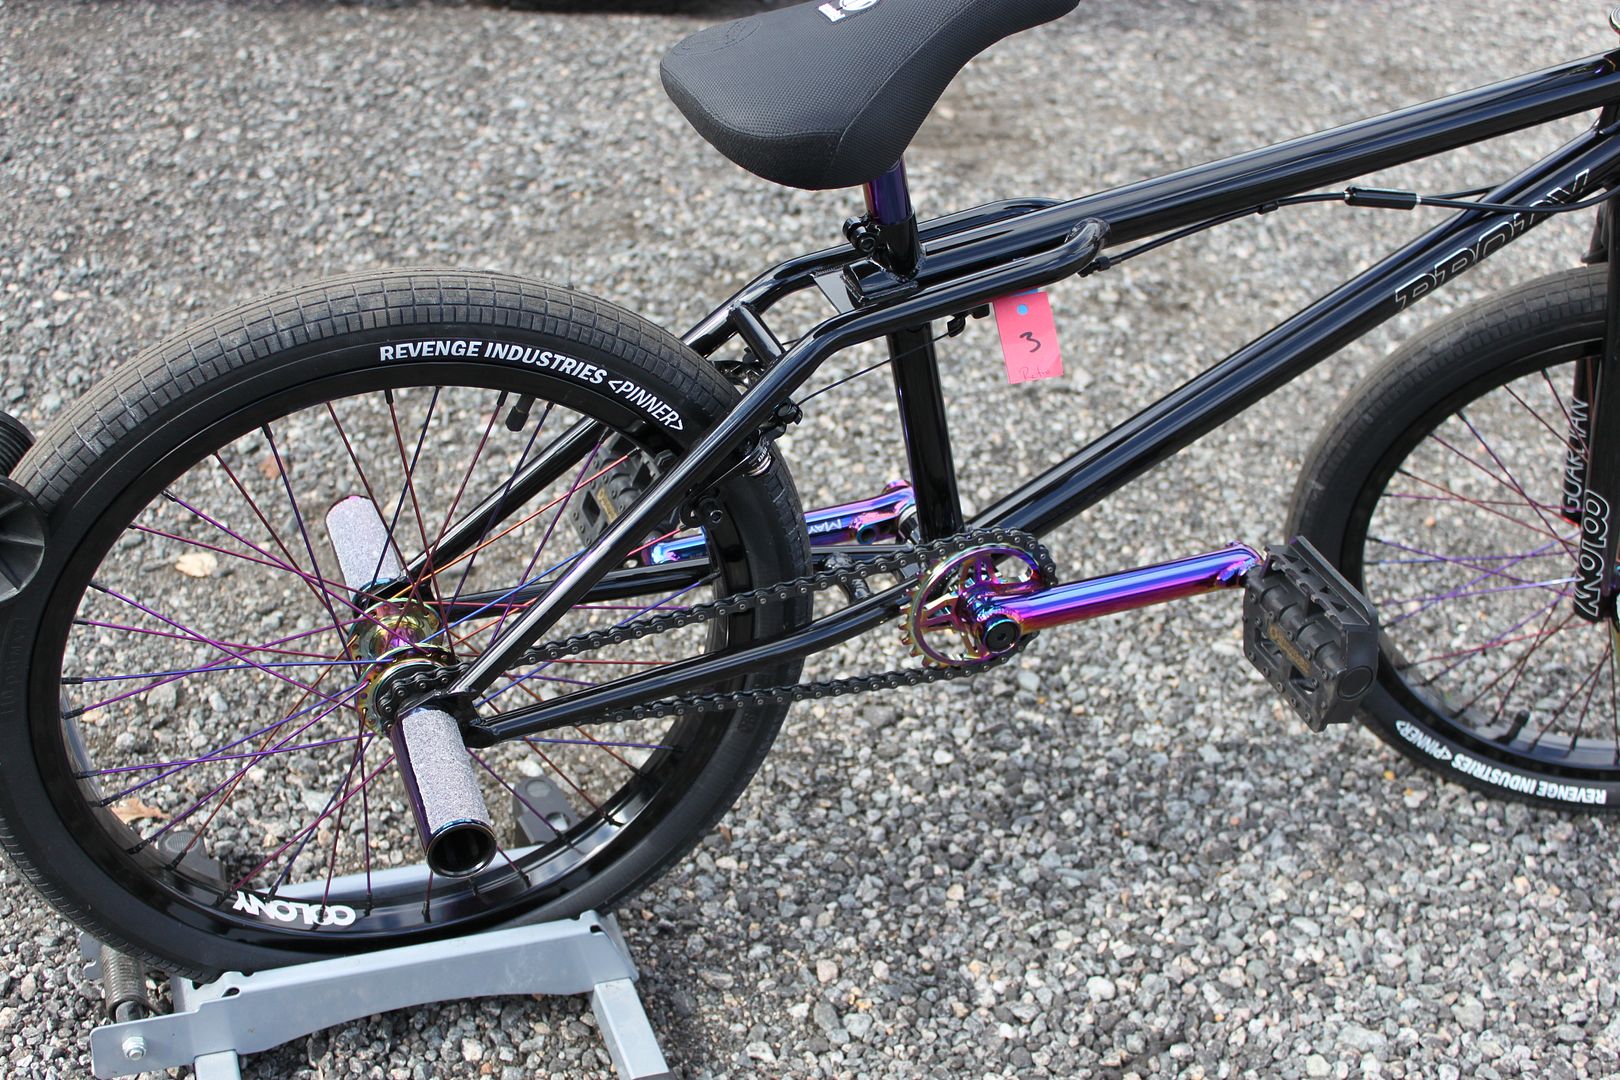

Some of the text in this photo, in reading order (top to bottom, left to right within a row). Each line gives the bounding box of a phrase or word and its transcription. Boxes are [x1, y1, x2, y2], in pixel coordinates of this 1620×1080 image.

[1019, 331, 1041, 353] 3
[379, 340, 482, 361] REVENGE
[483, 342, 608, 384] INDUSTRIES
[1450, 752, 1537, 795] INDUSTRIES
[1536, 780, 1608, 805] REVENGE
[232, 890, 357, 927] COLONY
